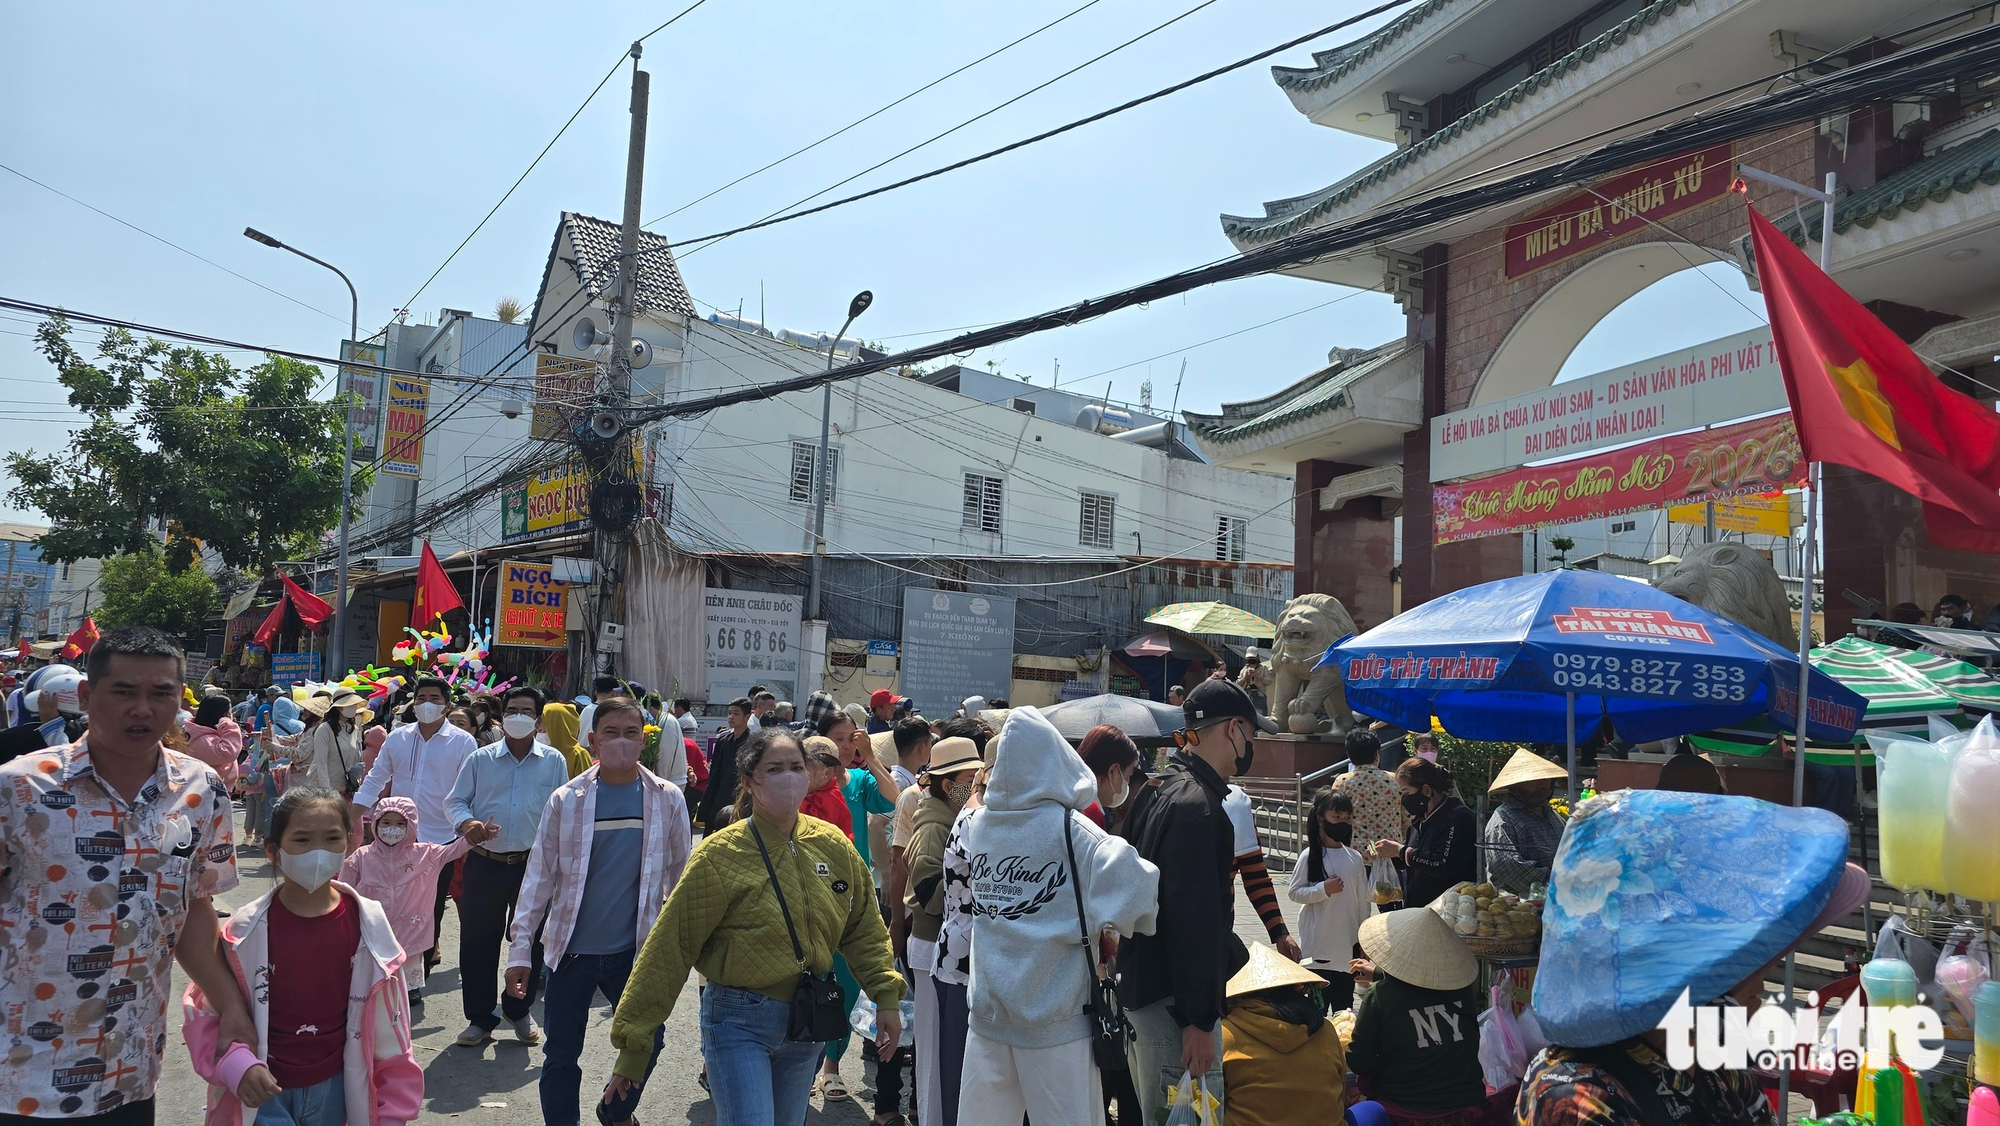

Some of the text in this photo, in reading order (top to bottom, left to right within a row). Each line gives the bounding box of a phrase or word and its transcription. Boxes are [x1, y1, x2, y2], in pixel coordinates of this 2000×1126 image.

[1525, 155, 1705, 261] MIẾU BÀ CHÚA XỨ
[394, 380, 424, 395] NHÀ
[1442, 418, 1451, 445] LỄ
[1453, 418, 1468, 445] HỘI
[1470, 414, 1485, 438] VÍA
[1488, 409, 1500, 434] BÀ
[1503, 403, 1529, 430] CHÚA
[1532, 397, 1547, 424] XỨ
[1549, 392, 1567, 419] NÚI
[1570, 389, 1593, 414] SAM
[1608, 382, 1619, 405] DI
[1623, 371, 1647, 401] SẢN
[1651, 365, 1676, 394] VĂN
[1680, 356, 1706, 387] HÓA
[1711, 352, 1732, 379] PHI
[1737, 340, 1763, 374] VẬT
[387, 409, 424, 436] MAI
[1525, 433, 1542, 457] ĐẠI
[1545, 424, 1568, 452] DIỆN
[1570, 416, 1593, 445] CỦA
[1596, 409, 1627, 440] NHÂN
[1631, 404, 1657, 434] LOẠI
[389, 436, 419, 461] VUI
[1461, 432, 1794, 523] Chúc Mừng Năm Mới 2026
[528, 490, 563, 522] NGỌC
[1608, 502, 1658, 517] KHANG
[511, 585, 562, 607] BÍCH
[726, 597, 746, 609] ANH
[747, 598, 772, 611] CHÂU
[773, 598, 793, 613] ĐỐC
[506, 607, 564, 628] GIỮ XE
[1588, 610, 1655, 619] ĐỨC
[717, 627, 736, 650] 66
[743, 629, 762, 652] 88
[768, 630, 787, 653] 66
[948, 631, 980, 642] KHÔNG
[1562, 618, 1703, 641] TÀI THÀNH
[1604, 634, 1671, 646] COFFEE
[1349, 651, 1499, 681] ĐỨC TÀI THÀNH
[1553, 652, 1746, 683] 0979.827 353
[1553, 670, 1746, 702] 0943.827 353
[1808, 696, 1857, 731] THÀNH
[972, 853, 1057, 884] Be Kind
[1408, 1000, 1464, 1048] NY
